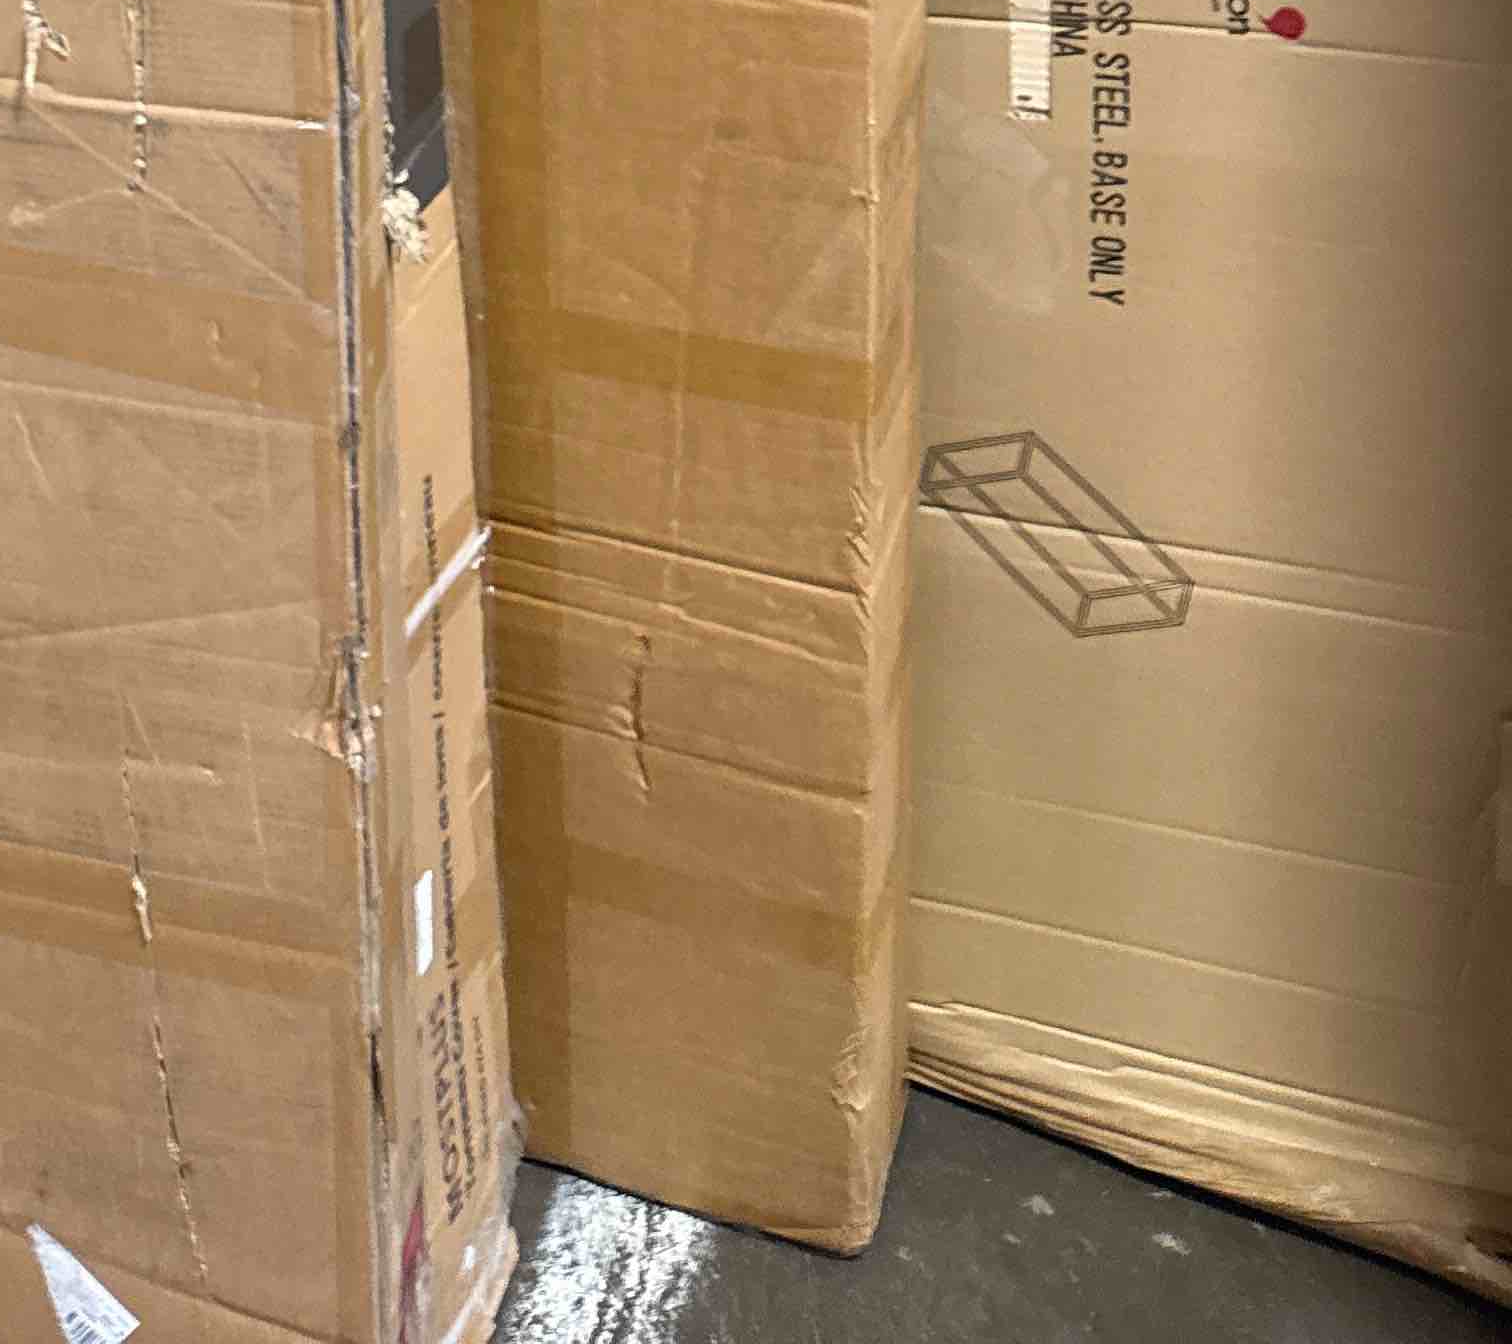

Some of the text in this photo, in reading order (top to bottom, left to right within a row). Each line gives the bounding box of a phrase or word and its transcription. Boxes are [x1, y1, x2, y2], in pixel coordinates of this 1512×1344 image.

[1090, 150, 1129, 226] BASE
[1088, 235, 1127, 307] ONLY
[428, 992, 464, 1225] MOSTPLUS
